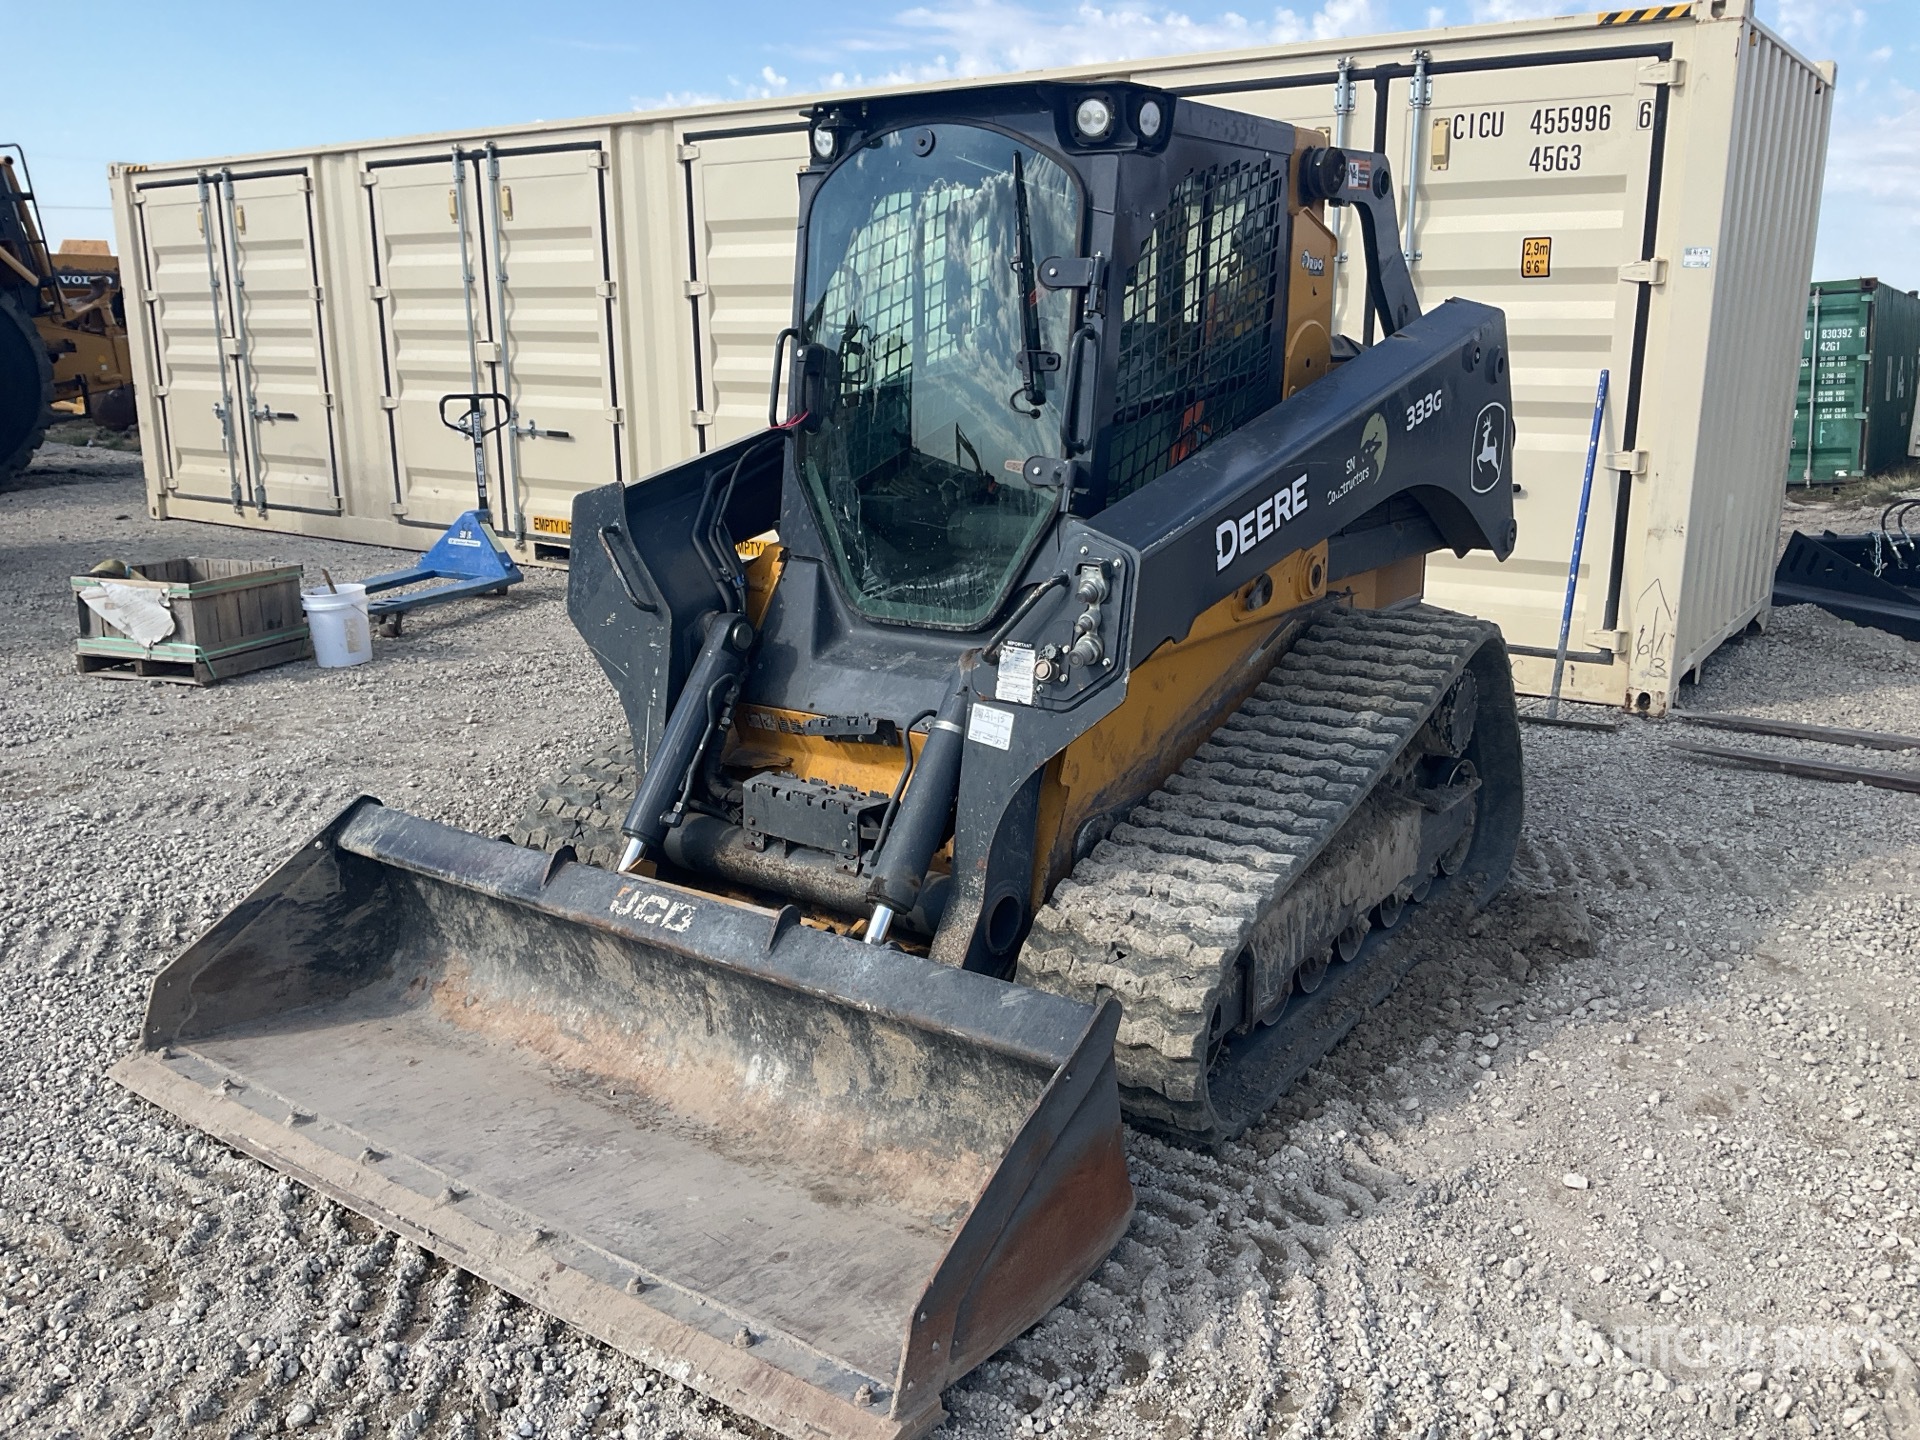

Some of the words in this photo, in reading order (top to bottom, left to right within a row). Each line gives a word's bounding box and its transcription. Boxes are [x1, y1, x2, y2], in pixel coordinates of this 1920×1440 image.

[1453, 111, 1504, 139] CICU
[1530, 104, 1611, 135] 455996
[1639, 101, 1651, 129] 6
[1529, 144, 1582, 172] 45G3
[1822, 328, 1853, 339] 830392
[1820, 341, 1840, 352] 42G1
[1406, 389, 1442, 431] 333G
[534, 517, 560, 533] EMPTY
[561, 521, 571, 534] LIF
[1216, 473, 1308, 572] DEERE
[737, 541, 761, 556] MPTY
